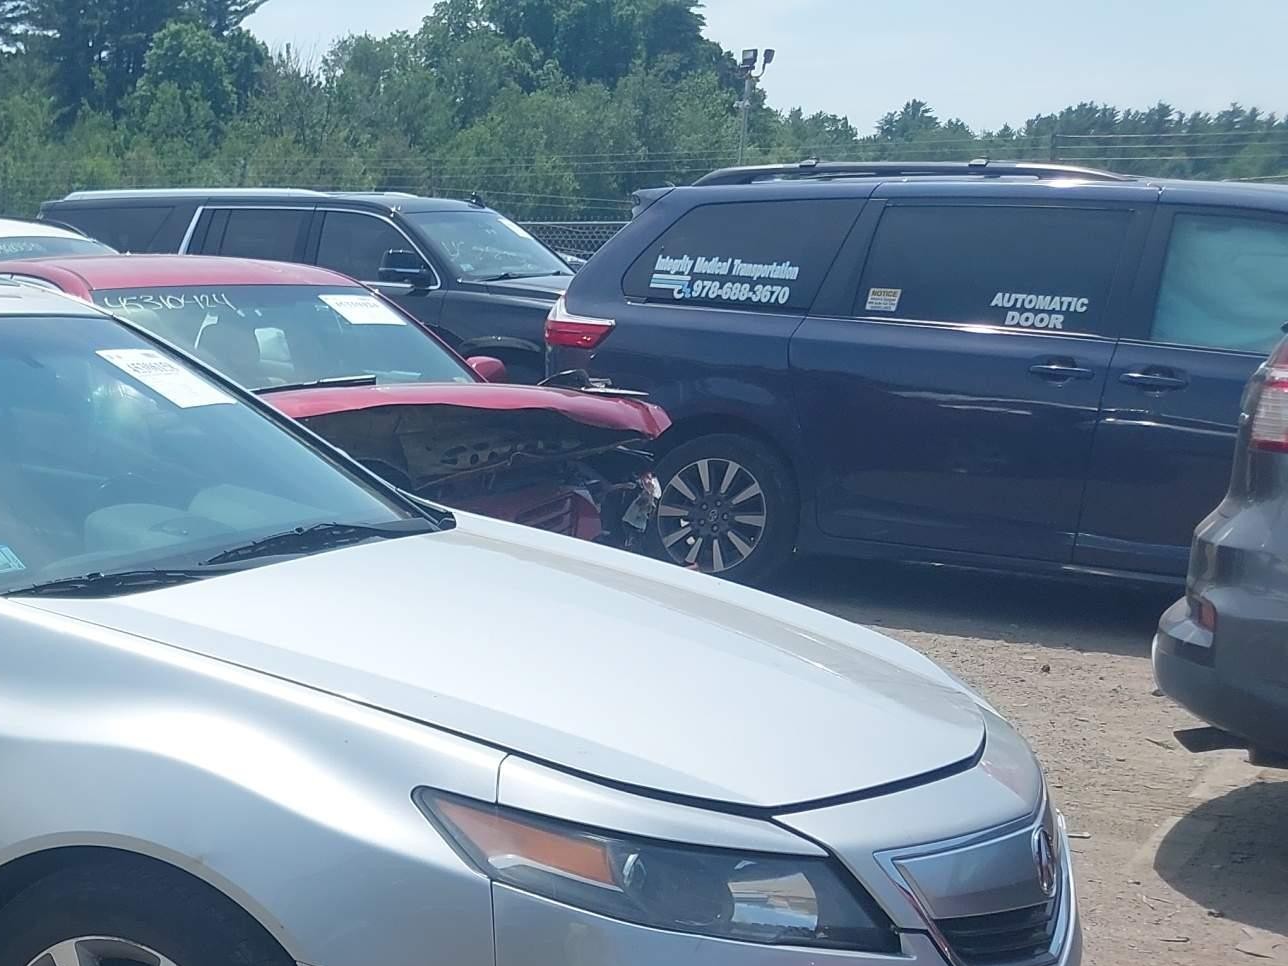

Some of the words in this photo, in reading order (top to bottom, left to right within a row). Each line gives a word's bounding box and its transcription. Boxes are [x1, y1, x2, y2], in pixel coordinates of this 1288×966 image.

[654, 254, 694, 275] Integrity
[693, 256, 732, 275] Medical
[732, 258, 800, 281] Transportation
[691, 279, 790, 304] 978-688-3670
[871, 290, 899, 298] NOTICE
[989, 292, 1089, 313] AUTOMATIC
[1004, 311, 1065, 329] DOOR
